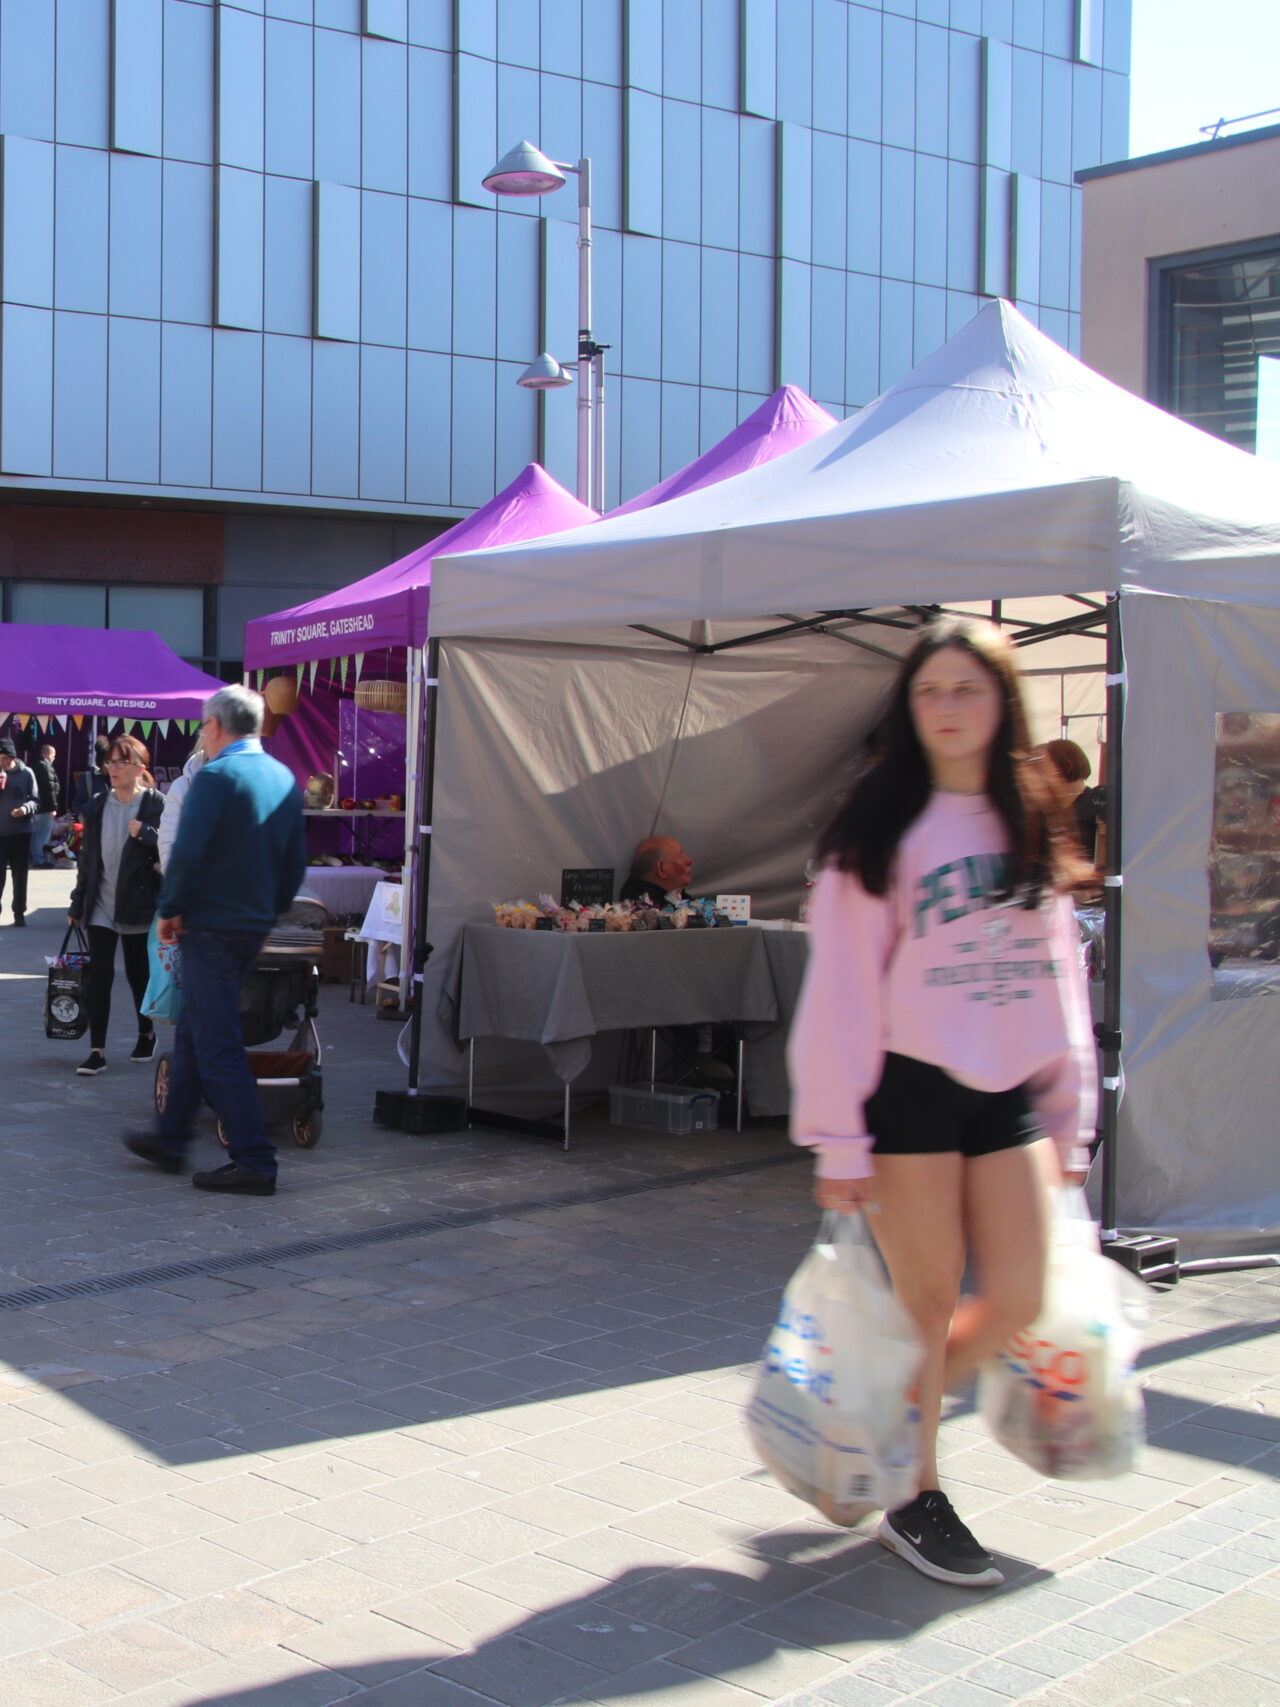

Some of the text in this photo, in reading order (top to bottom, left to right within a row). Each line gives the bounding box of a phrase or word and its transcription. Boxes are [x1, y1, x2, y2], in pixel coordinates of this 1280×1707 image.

[270, 614, 374, 646] TRINITY SQUARE, GATESHEAD
[36, 696, 157, 709] TRINITY SQUARE, GATESHEAD
